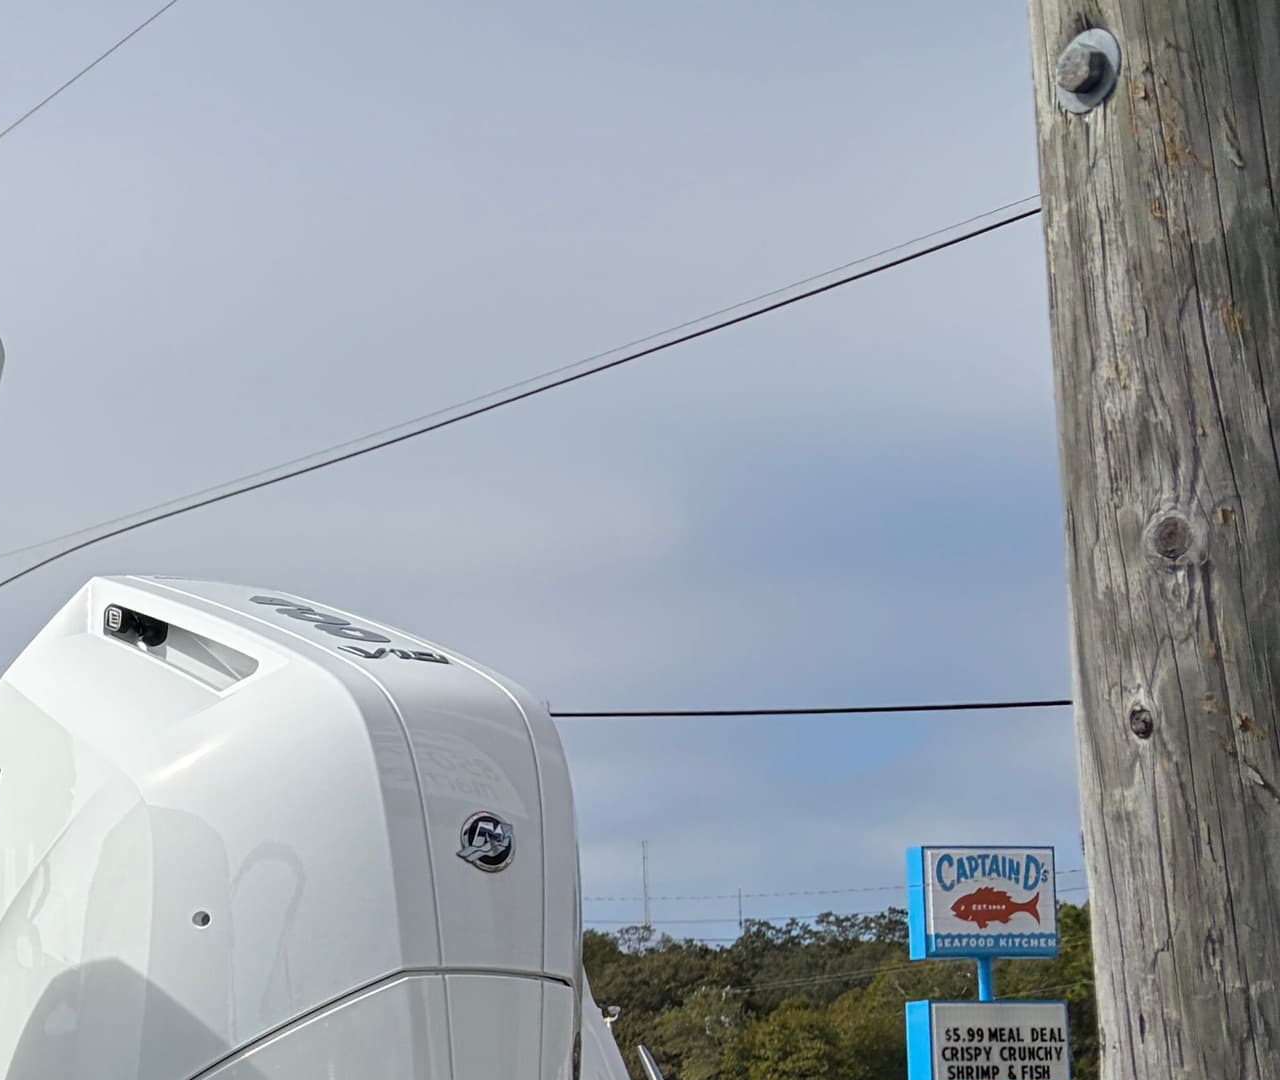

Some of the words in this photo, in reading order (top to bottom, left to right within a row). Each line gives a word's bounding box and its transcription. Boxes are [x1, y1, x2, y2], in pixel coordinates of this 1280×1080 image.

[936, 854, 1020, 892] CAPTAIN
[936, 937, 995, 948] SEAFOOD
[1000, 937, 1057, 948] KITCHEN
[945, 1027, 984, 1043] $5.99
[988, 1027, 1024, 1042] MEAL
[1031, 1027, 1065, 1042] DEAL
[942, 1046, 992, 1061] CRISPY
[1000, 1046, 1063, 1061] CRUNCHY
[947, 1065, 1000, 1080] SHRIMP
[1007, 1065, 1017, 1080] &
[1021, 1065, 1051, 1080] FISH
